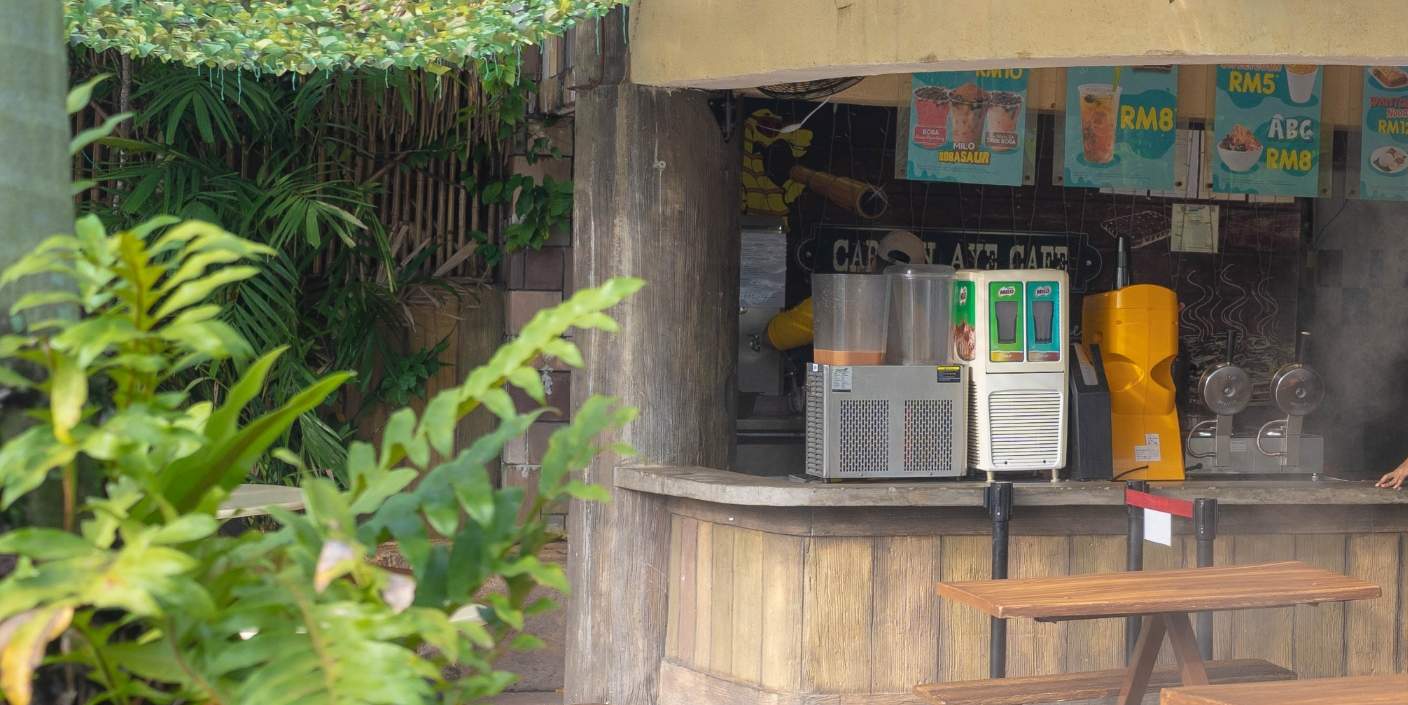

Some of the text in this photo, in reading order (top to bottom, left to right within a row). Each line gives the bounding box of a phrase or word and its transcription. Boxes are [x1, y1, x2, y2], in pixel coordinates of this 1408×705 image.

[1229, 70, 1277, 95] RM5
[1120, 105, 1174, 131] RM8
[1267, 113, 1314, 140] ABC
[953, 142, 976, 150] MILO
[1266, 147, 1312, 171] RM8
[952, 242, 998, 269] AYE
[1009, 244, 1070, 270] CAFE
